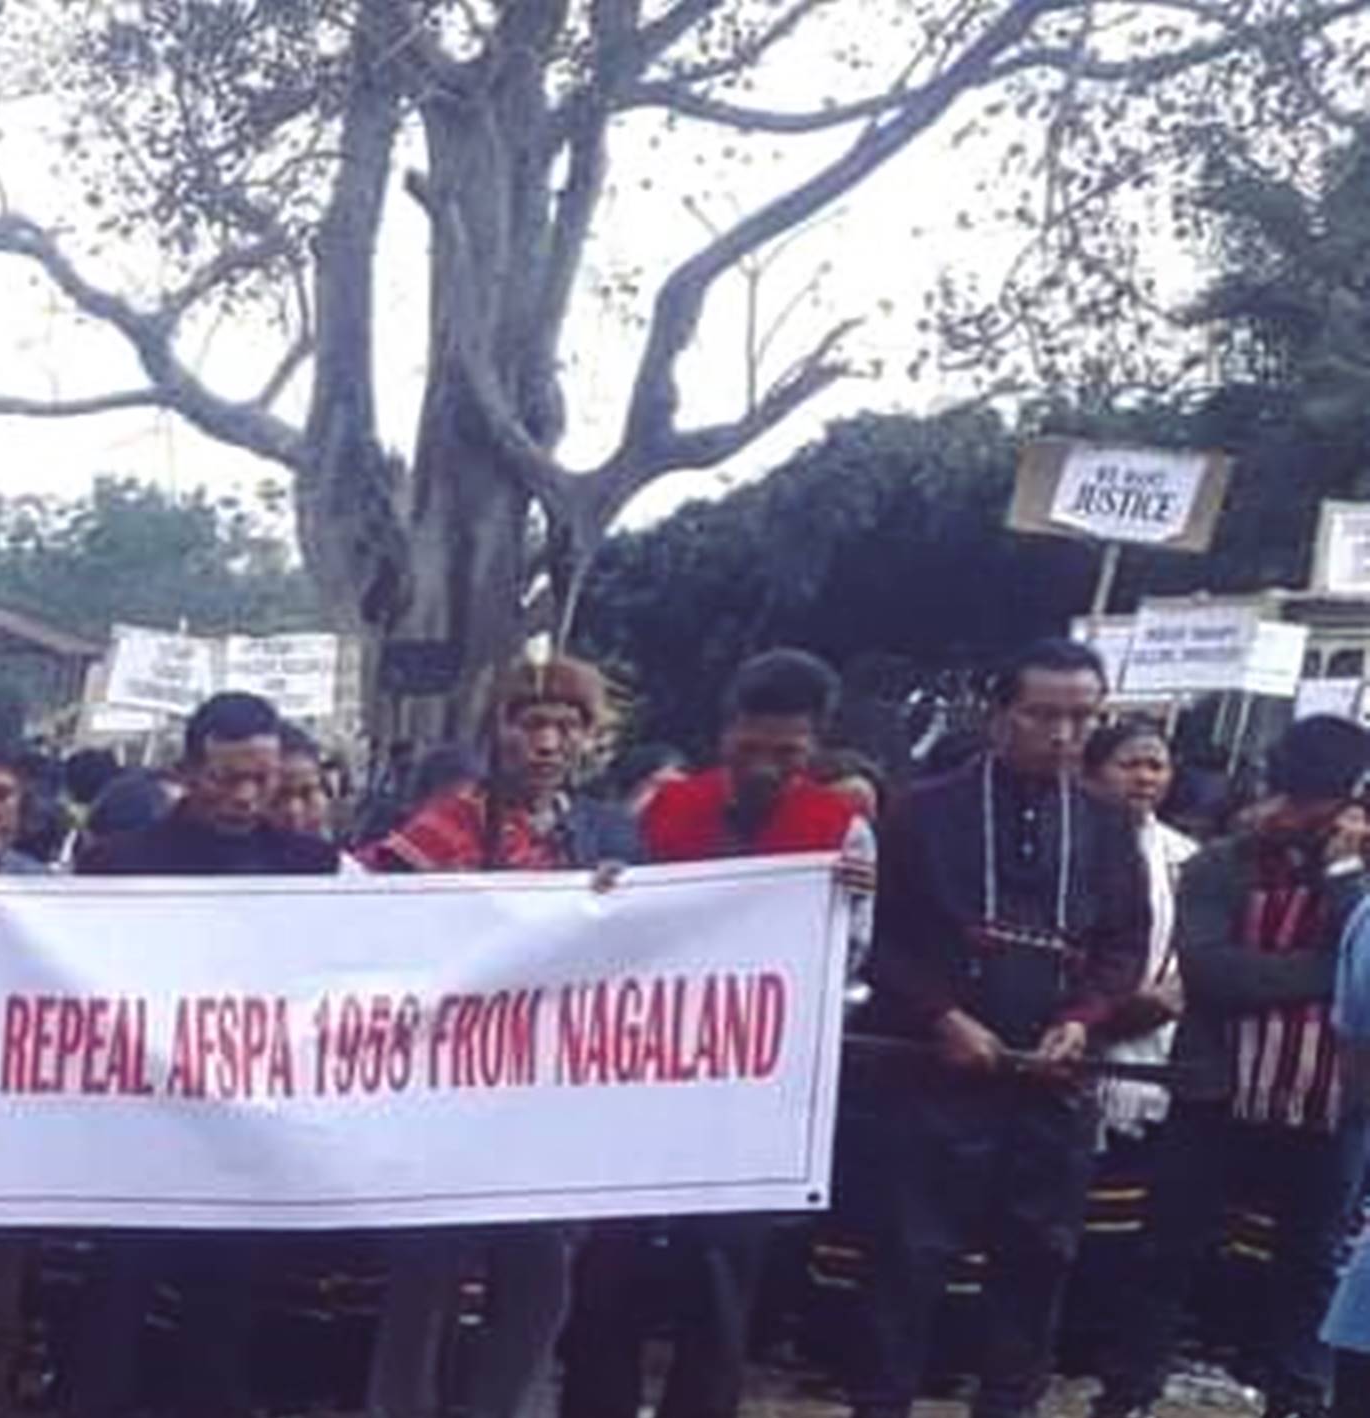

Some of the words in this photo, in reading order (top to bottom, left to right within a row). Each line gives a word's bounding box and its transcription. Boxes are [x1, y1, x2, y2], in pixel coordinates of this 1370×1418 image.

[0, 995, 154, 1095] REPEAL
[167, 996, 295, 1097] AFSPA
[313, 992, 419, 1095] 1958
[429, 986, 543, 1088] FROM
[556, 972, 786, 1086] NAGALAND
